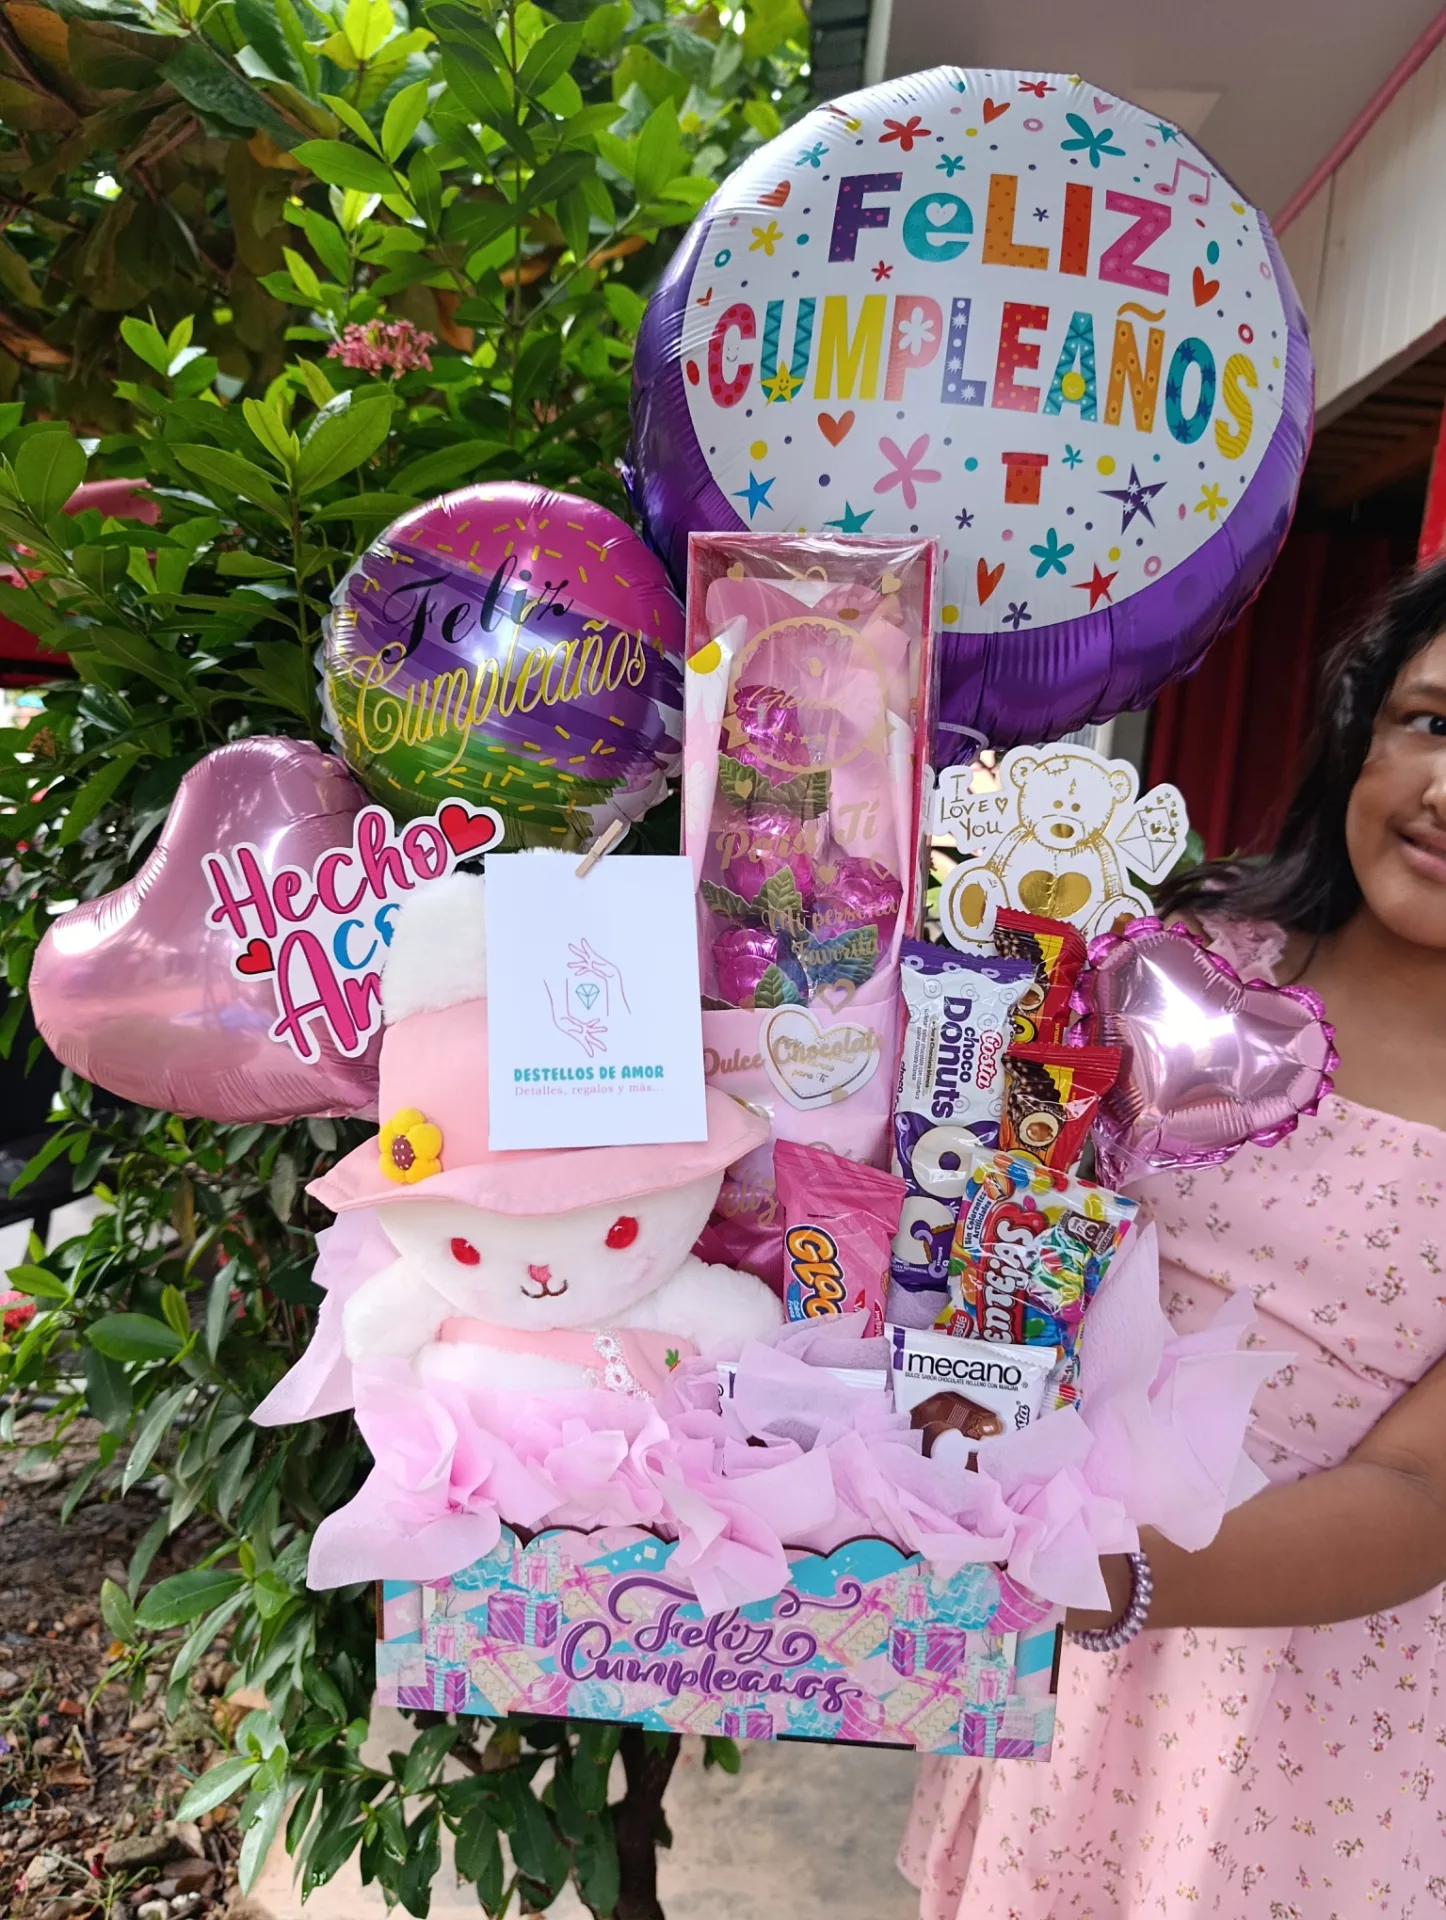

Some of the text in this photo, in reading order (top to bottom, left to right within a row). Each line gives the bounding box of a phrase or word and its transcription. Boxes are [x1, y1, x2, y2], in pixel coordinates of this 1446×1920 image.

[829, 172, 1171, 295] FeLIZ
[708, 294, 1259, 460] CUMPLEAÑOS
[381, 555, 573, 664] Feliz
[349, 618, 646, 777] Cumpleaños
[950, 774, 966, 803] I
[941, 799, 990, 824] LOVE
[211, 809, 450, 940] Hecho
[762, 895, 900, 938] Mi persona
[791, 931, 880, 969] Favorita
[514, 1065, 664, 1082] DESTELLOS DE AMOR
[702, 1048, 764, 1078] Dulce
[931, 996, 973, 1119] Donuts
[959, 1026, 980, 1083] choco
[976, 1029, 1004, 1090] Costa
[515, 1086, 567, 1097] Detalles,
[572, 1084, 613, 1096] regalos
[617, 1084, 625, 1094] y
[966, 1192, 987, 1231] Colorantes
[973, 1200, 993, 1240] Artificiales
[905, 1371, 920, 1380] DULCE
[921, 1373, 937, 1381] SABOR
[938, 1375, 966, 1386] CHOCOLATE
[908, 1353, 1022, 1386] mecano
